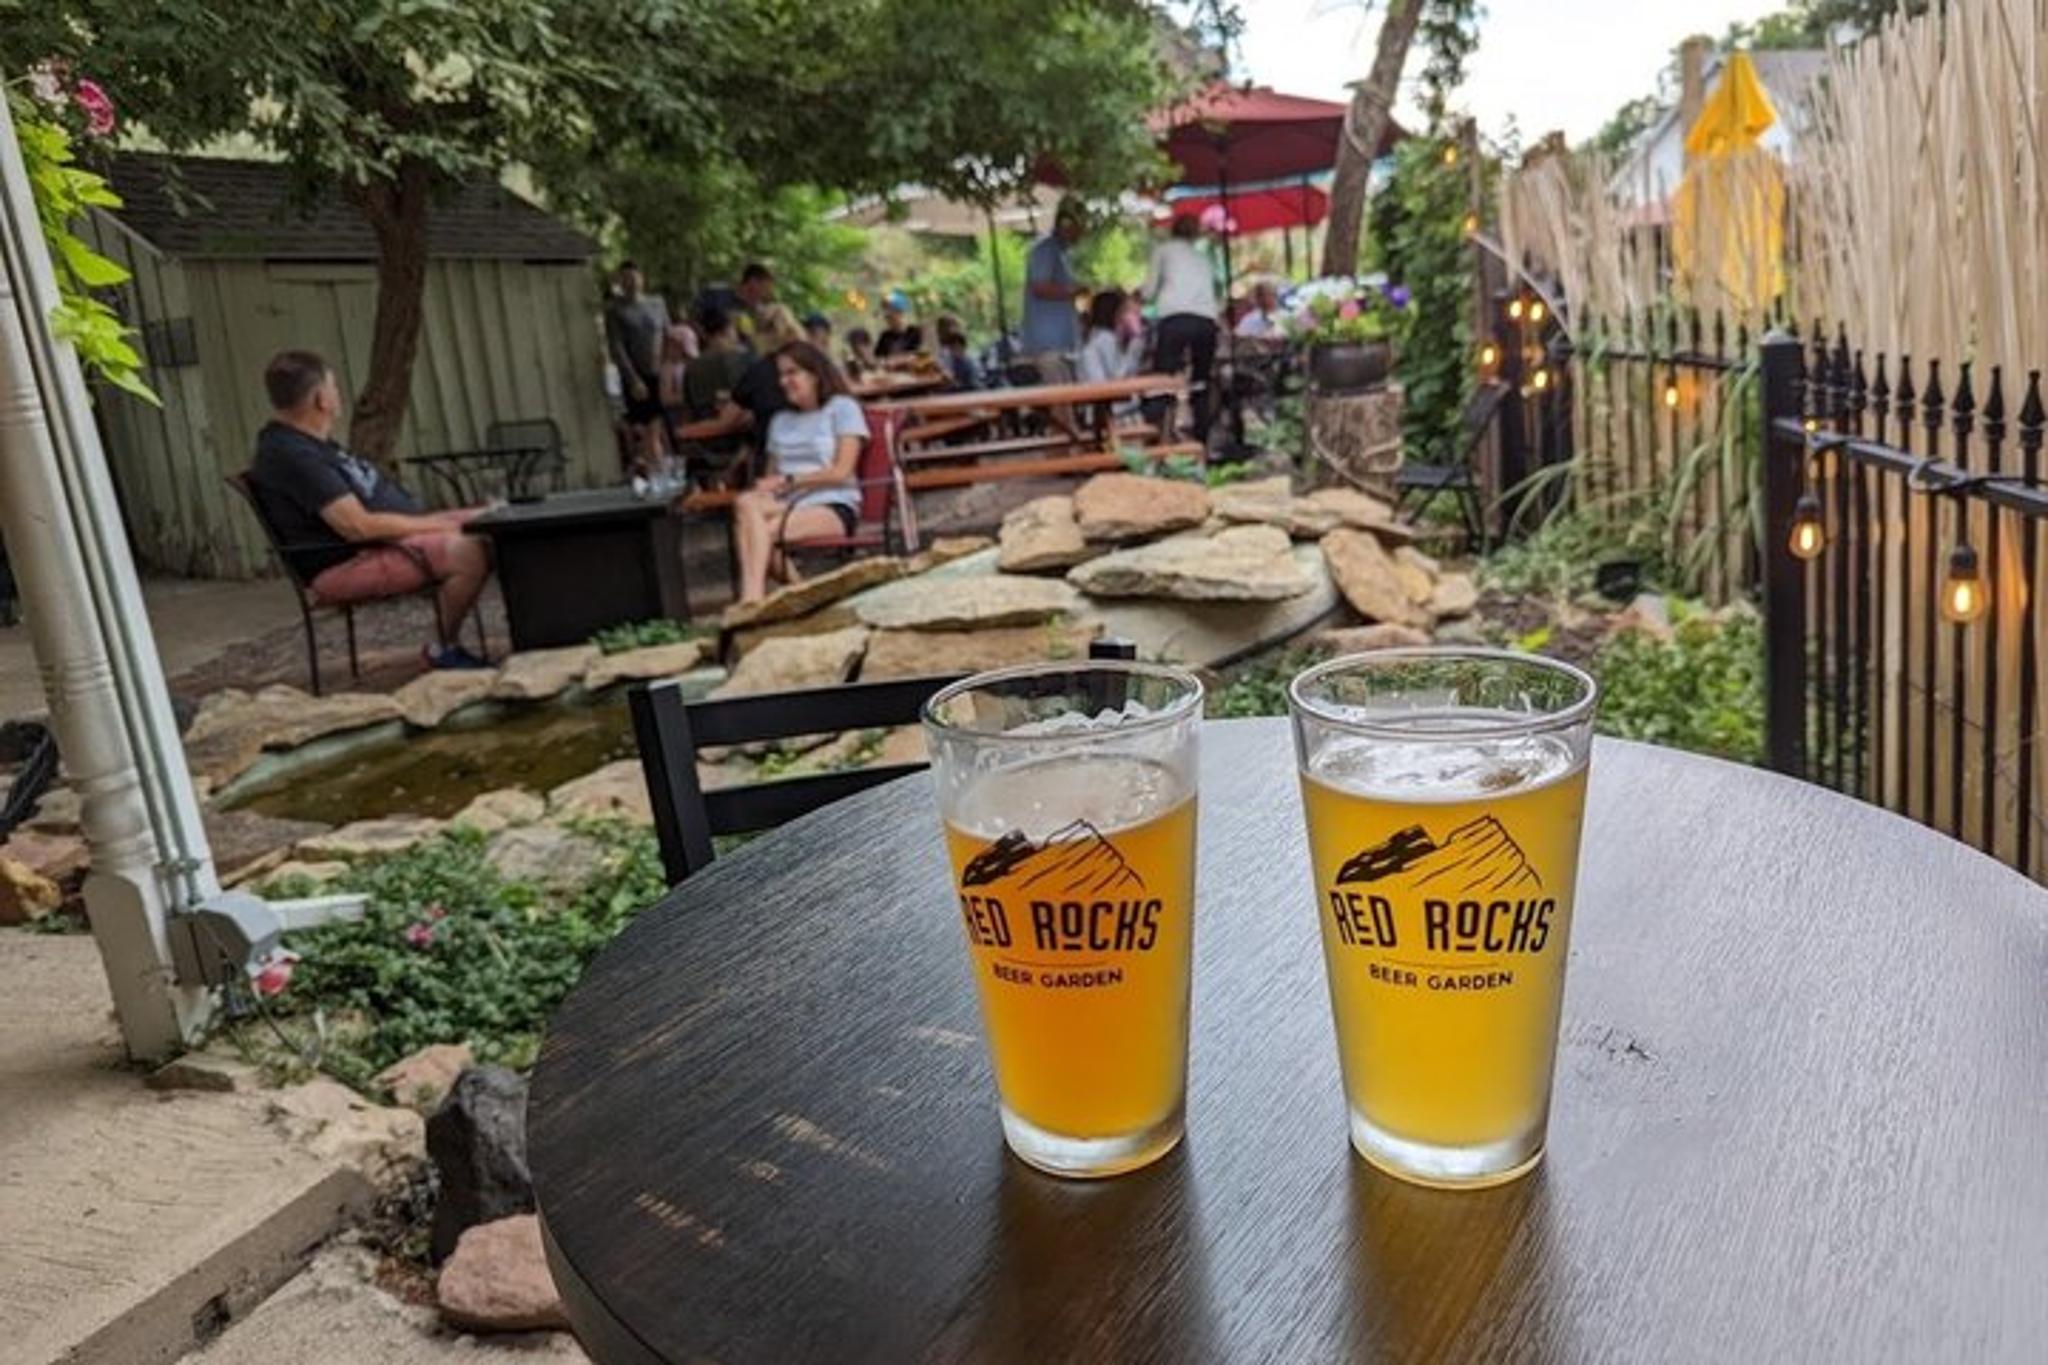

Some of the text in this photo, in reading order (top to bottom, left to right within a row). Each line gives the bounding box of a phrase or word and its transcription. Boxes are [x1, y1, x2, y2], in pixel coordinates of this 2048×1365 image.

[1330, 889, 1397, 948] RED
[993, 962, 1123, 988] BEER GARDEN
[1369, 963, 1513, 990] BEER GARDEN
